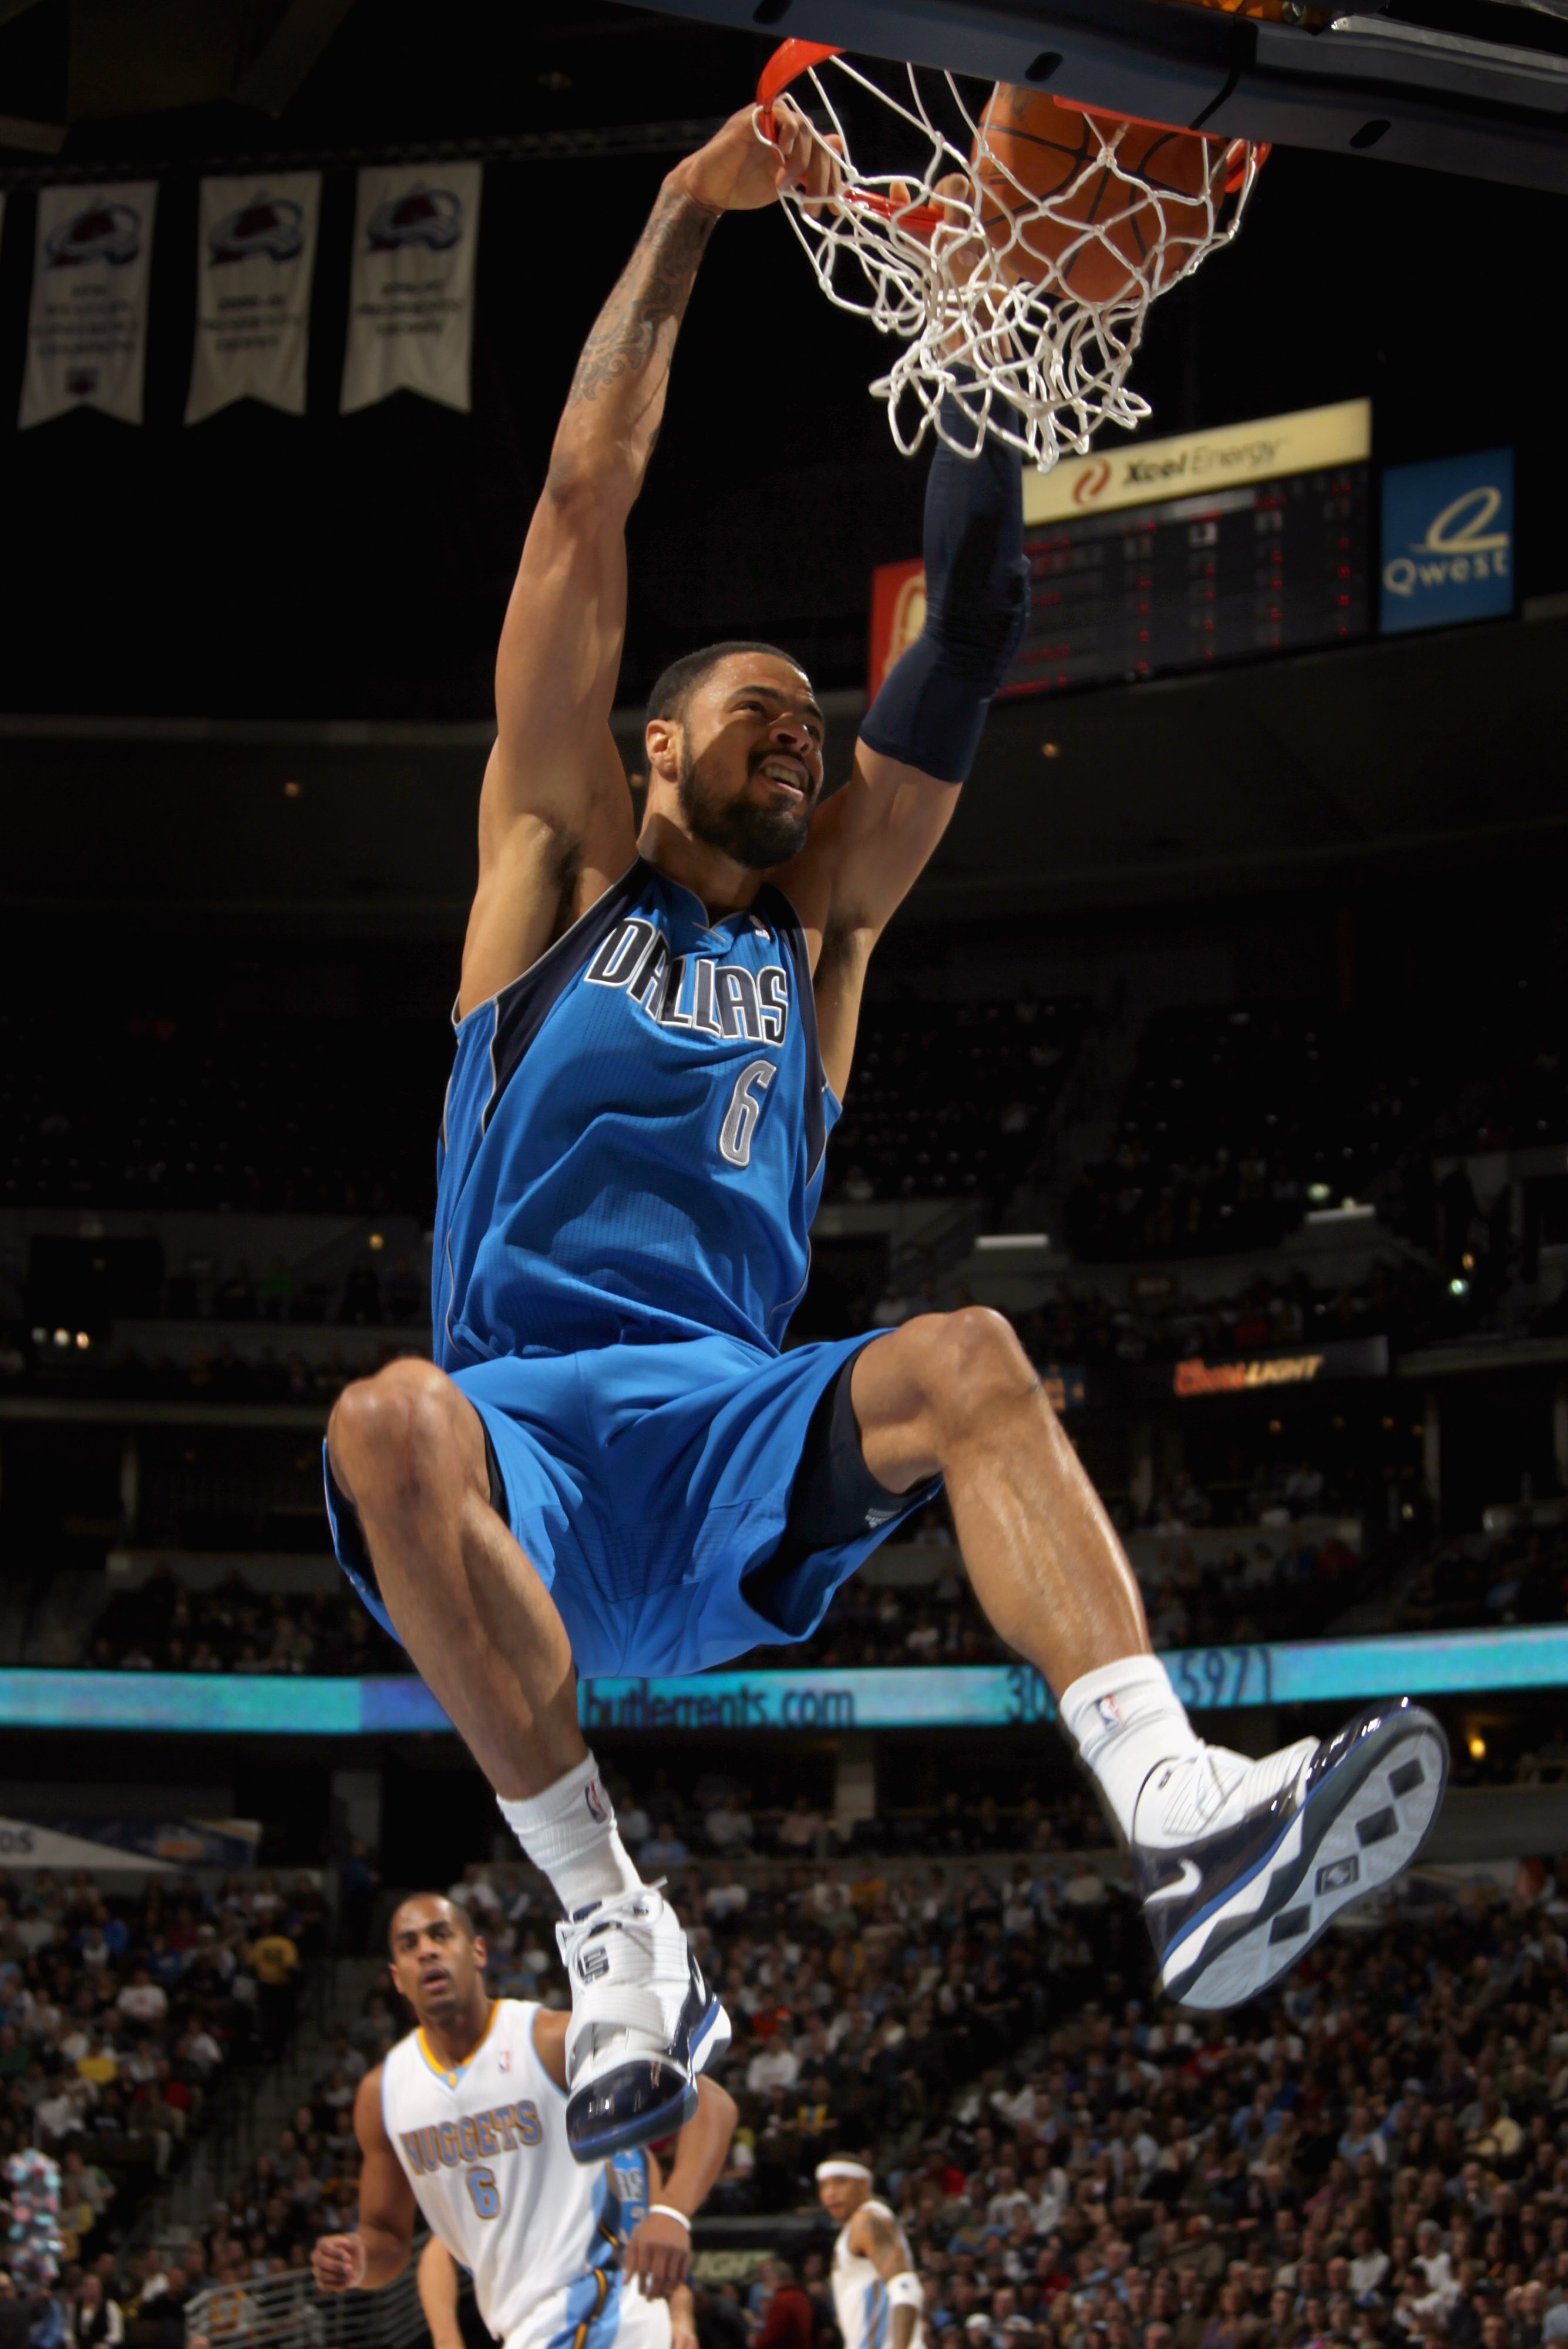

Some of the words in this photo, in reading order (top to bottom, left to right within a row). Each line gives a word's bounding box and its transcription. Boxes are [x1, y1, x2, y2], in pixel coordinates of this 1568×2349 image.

[1123, 451, 1187, 486] Xcel
[1191, 436, 1281, 471] Energy
[1383, 548, 1508, 598] Qwest
[584, 917, 788, 1048] DALLAS
[718, 1059, 778, 1168] 6
[1245, 1354, 1324, 1385] LIGHT
[401, 2099, 543, 2176] NUGGETS
[466, 2165, 500, 2219] 6
